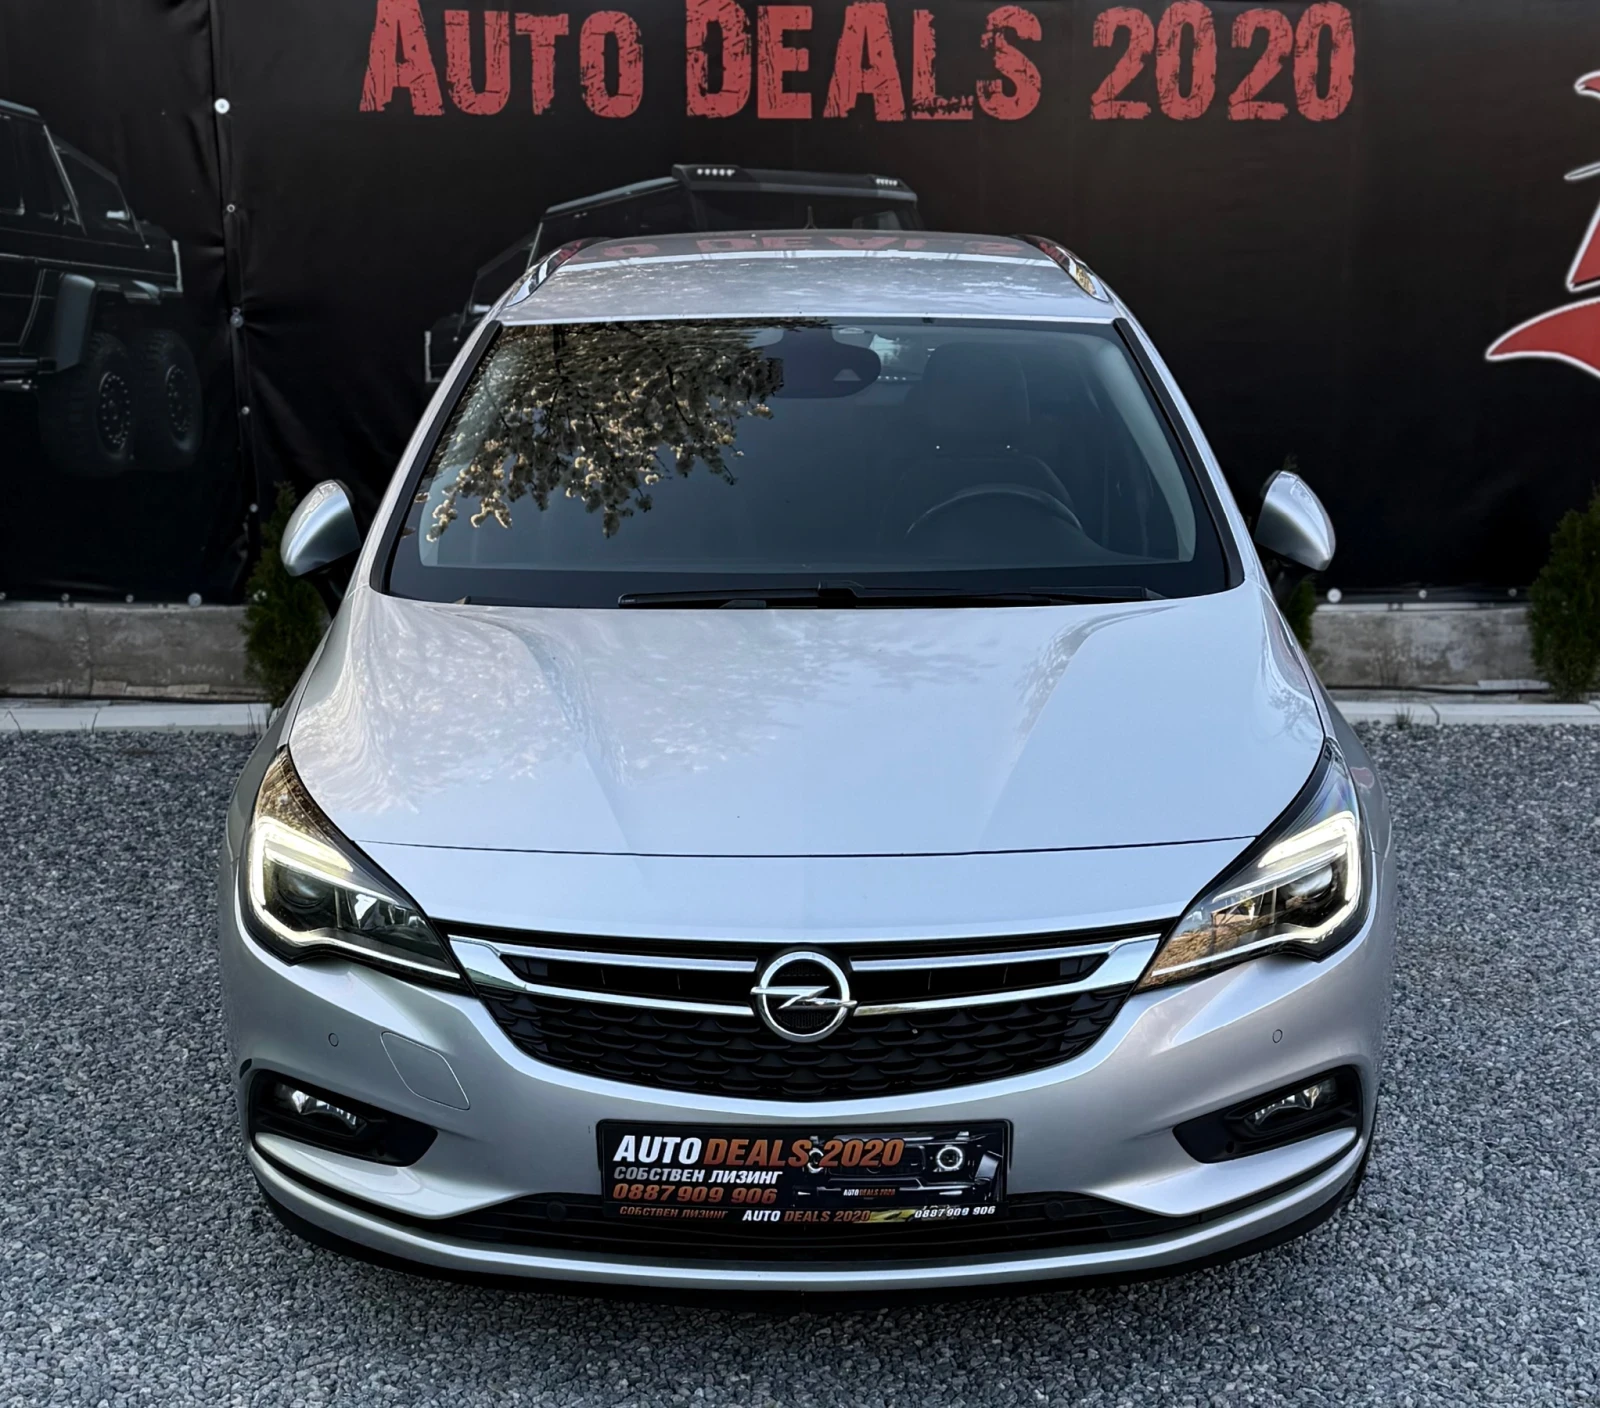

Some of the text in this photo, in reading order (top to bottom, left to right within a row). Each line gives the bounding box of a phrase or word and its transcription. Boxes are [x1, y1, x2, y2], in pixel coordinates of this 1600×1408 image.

[359, 0, 1356, 122] AUTO DEALS 2020
[613, 1135, 904, 1168] AUTO DEALS 2020
[613, 1166, 783, 1185] СОБСТВЕН ЛИЗИНГ
[612, 1183, 778, 1204] 0887 909 906
[843, 1188, 859, 1197] AUTO
[619, 1206, 728, 1219] СОБСТВЕН ЛИЗИНГ
[742, 1210, 871, 1222] AUTO DEALS 2020
[914, 1205, 996, 1219] 0887 909 906
